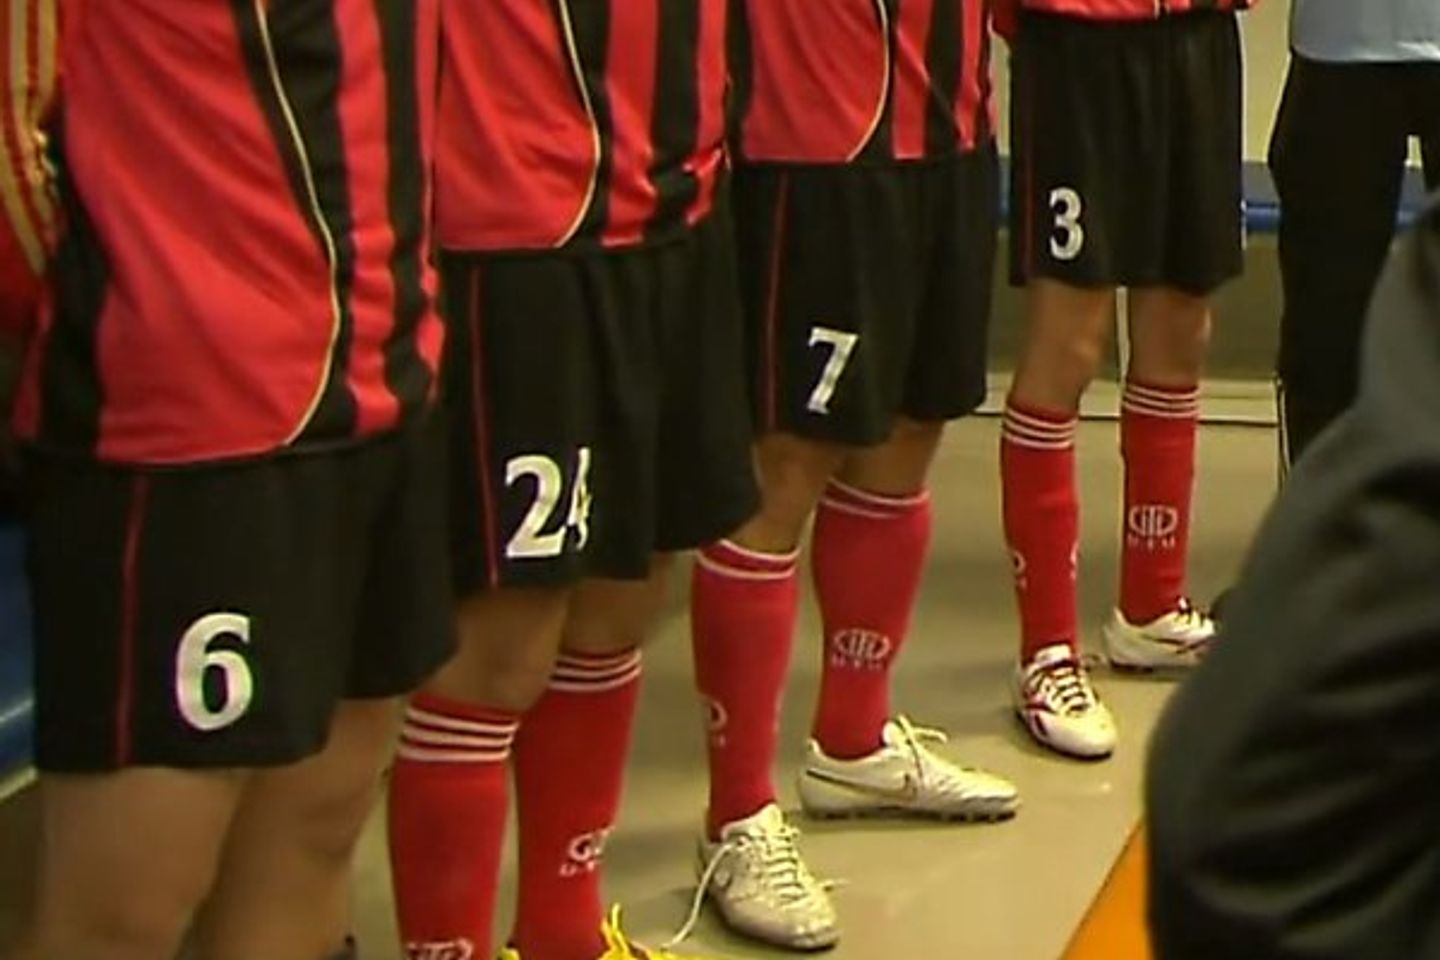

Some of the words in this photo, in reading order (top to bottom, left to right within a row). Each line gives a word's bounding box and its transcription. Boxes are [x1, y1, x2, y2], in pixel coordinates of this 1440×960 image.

[1049, 186, 1085, 260] 3
[807, 326, 859, 415] 7
[175, 612, 254, 731] 6
